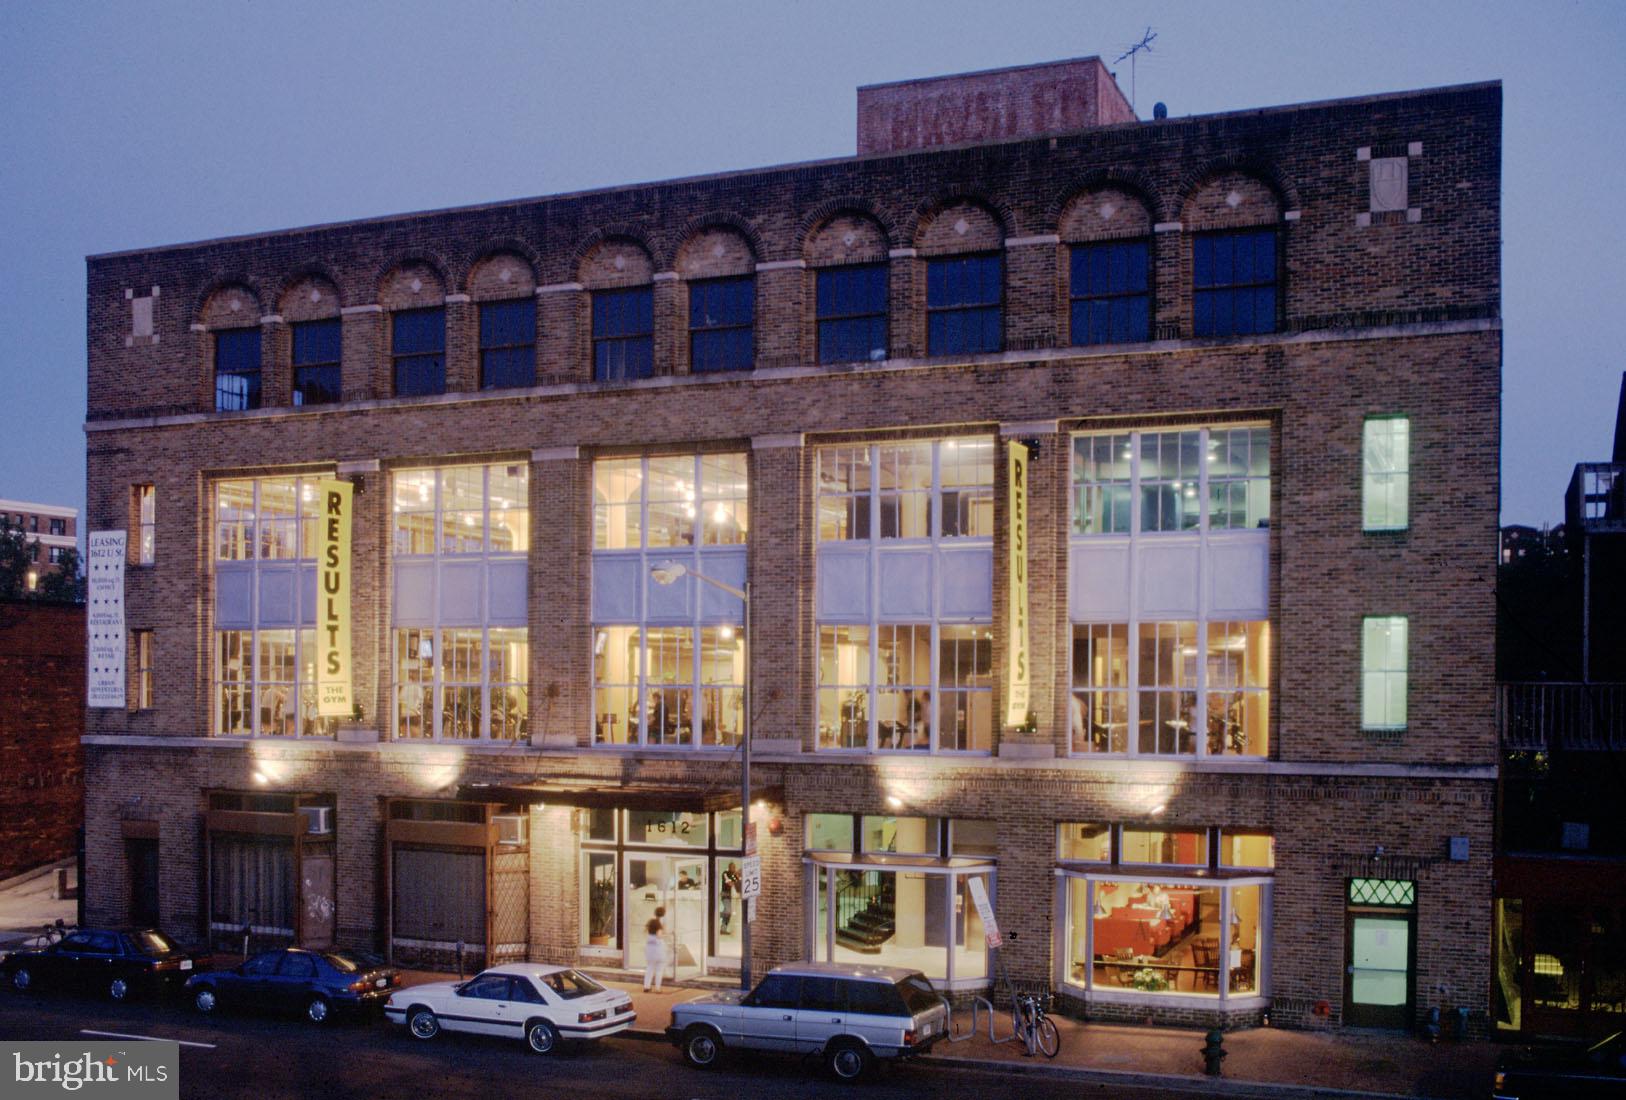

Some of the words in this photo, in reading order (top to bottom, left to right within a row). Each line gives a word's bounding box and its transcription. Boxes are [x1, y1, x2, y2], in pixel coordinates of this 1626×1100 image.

[91, 537, 124, 547] LEASING
[324, 491, 342, 674] RESULTS
[326, 686, 343, 694] THE
[323, 695, 346, 704] GYM
[646, 820, 691, 834] 1612
[744, 877, 760, 894] 25
